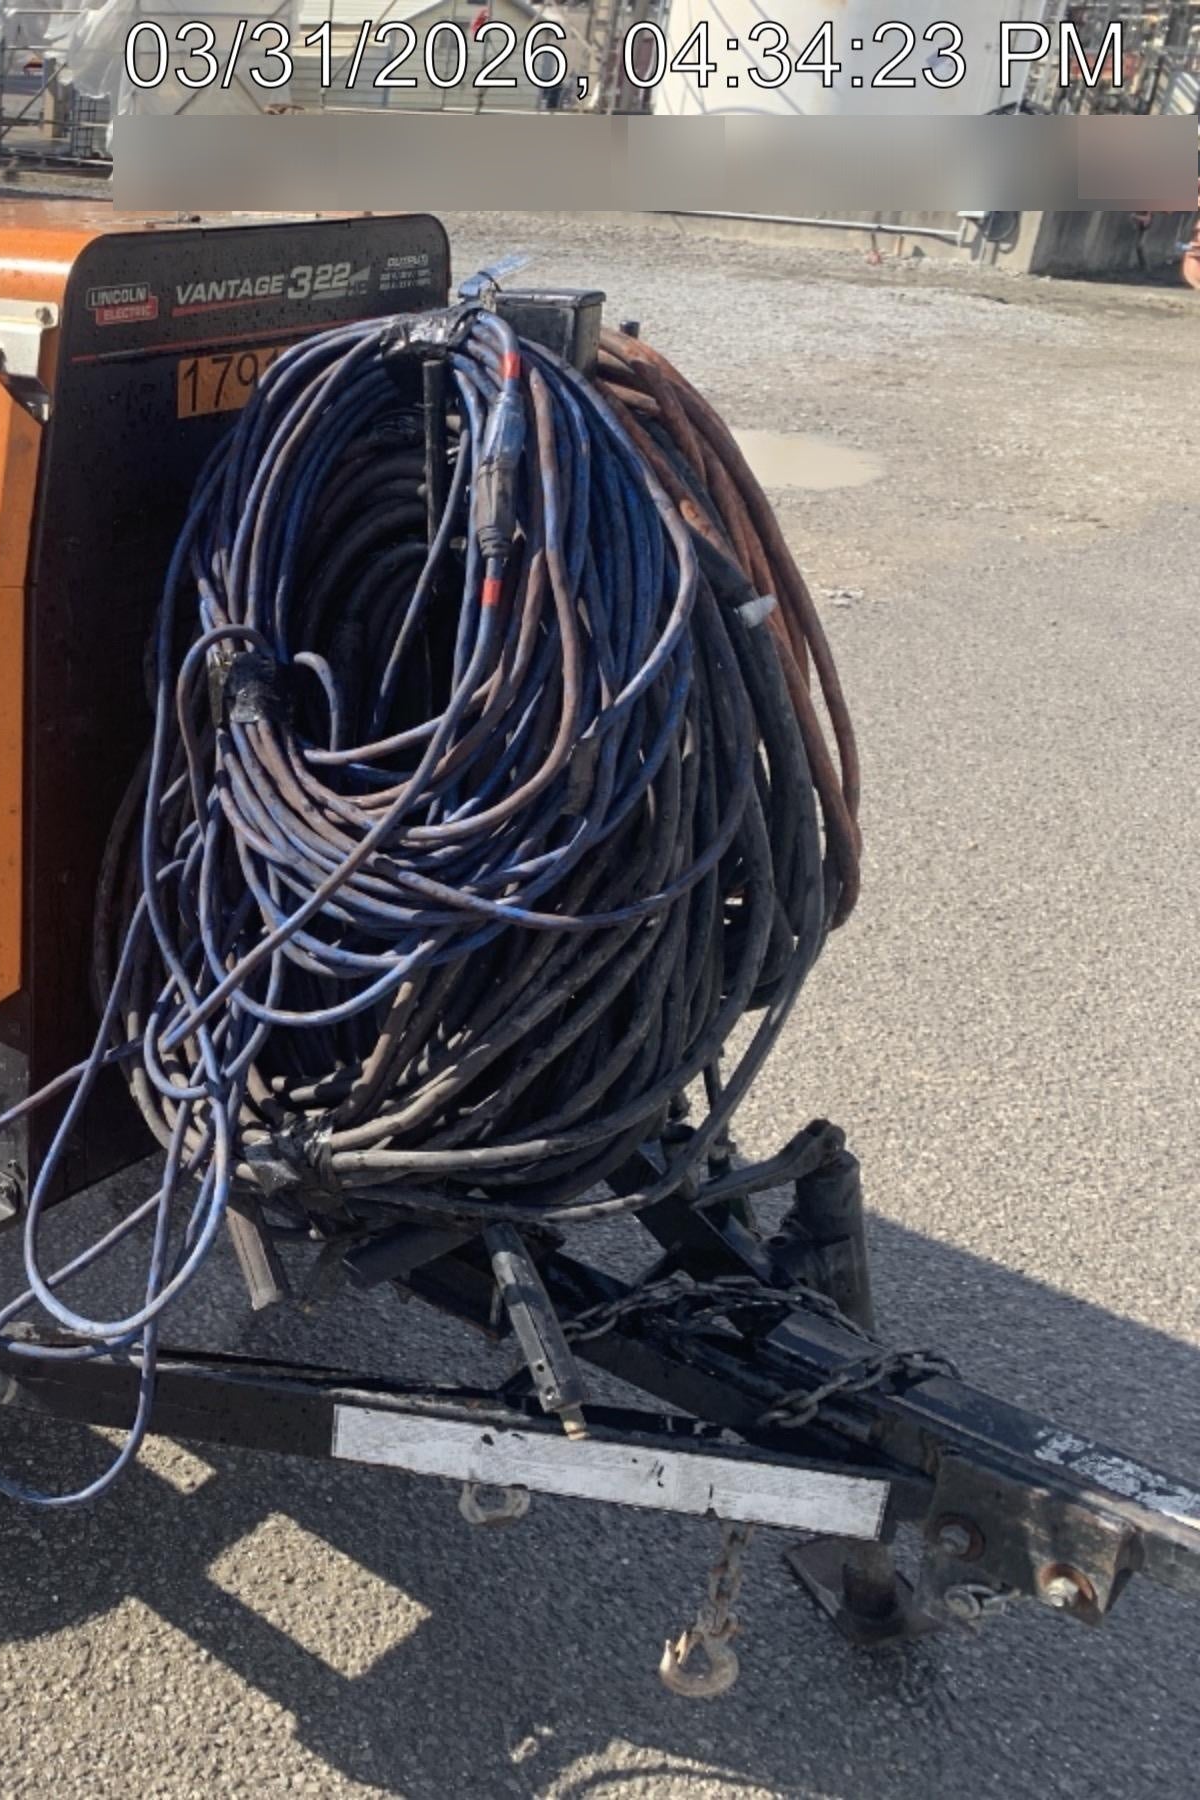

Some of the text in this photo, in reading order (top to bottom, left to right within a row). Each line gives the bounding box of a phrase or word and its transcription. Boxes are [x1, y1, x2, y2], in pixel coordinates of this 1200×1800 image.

[90, 286, 149, 306] LINCOLN
[176, 274, 286, 305] VANTAGE
[287, 261, 351, 299] 322
[103, 305, 152, 321] ELECTRIC
[183, 348, 280, 412] 179
